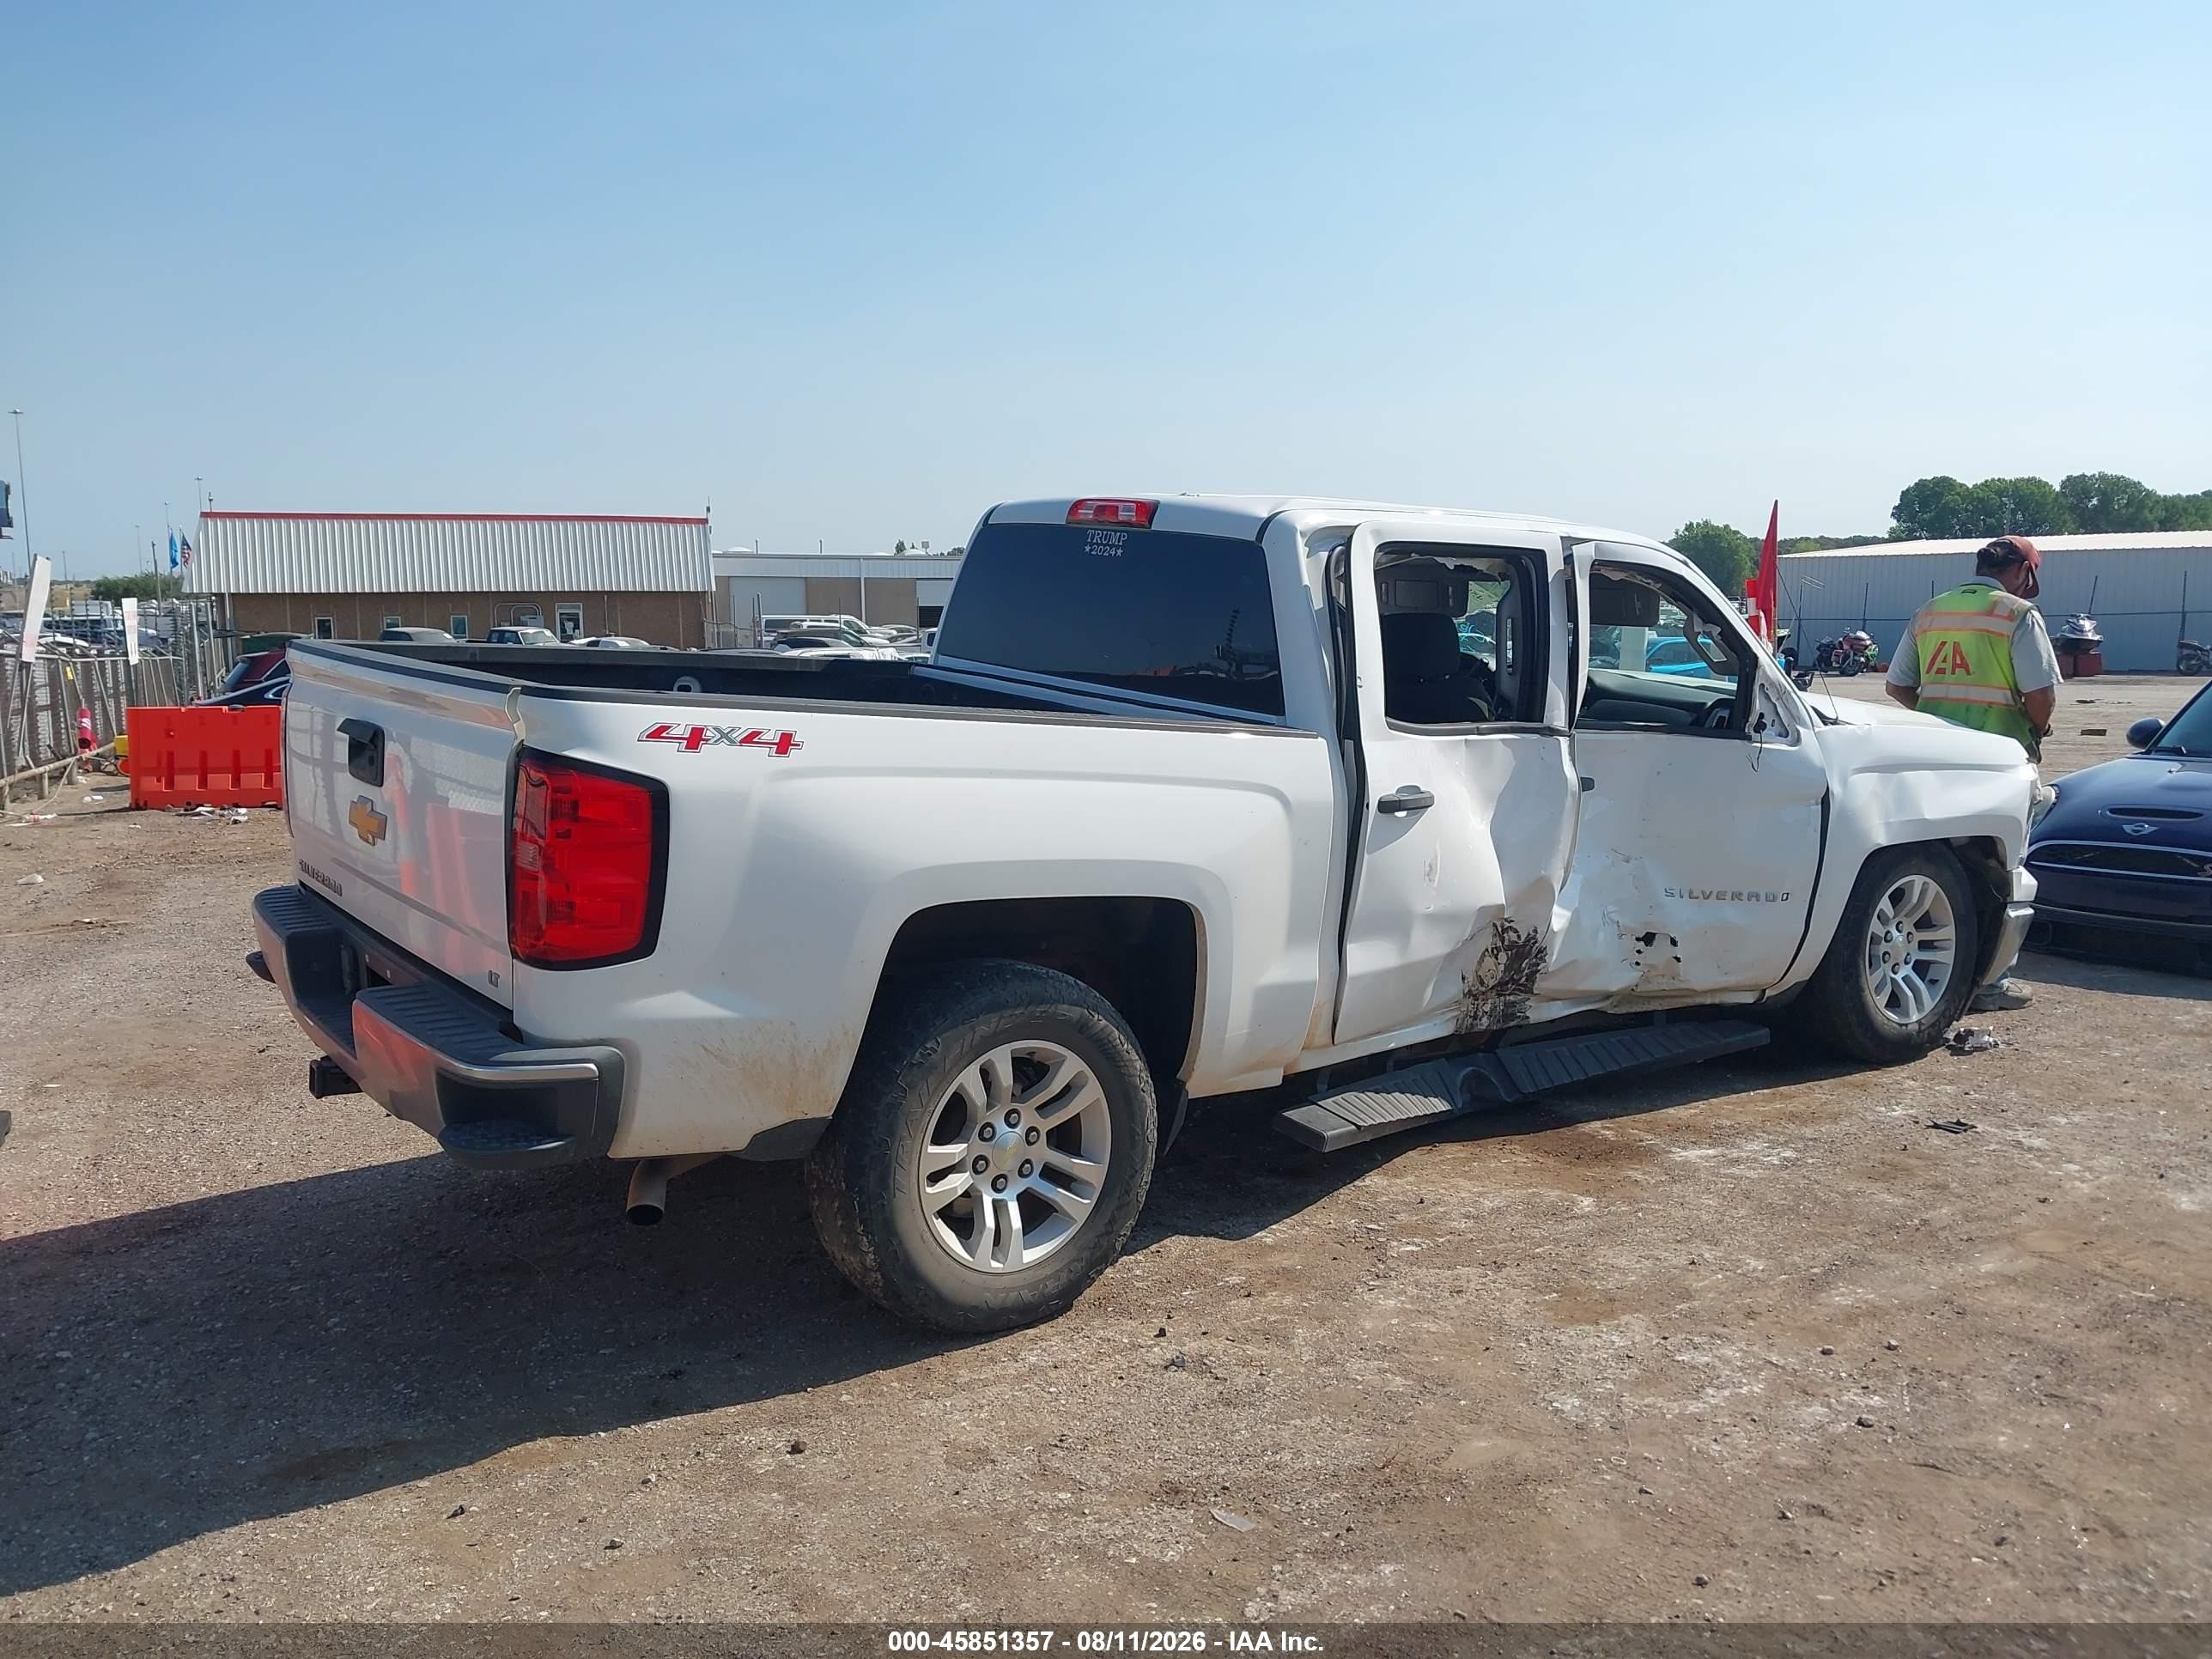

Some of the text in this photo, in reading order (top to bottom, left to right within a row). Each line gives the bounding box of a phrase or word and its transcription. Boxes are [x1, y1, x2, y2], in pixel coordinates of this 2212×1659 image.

[1086, 529, 1127, 545] TRUMP
[1091, 544, 1116, 557] 2024
[1664, 887, 1790, 902] SILVERADO
[488, 969, 500, 988] LT
